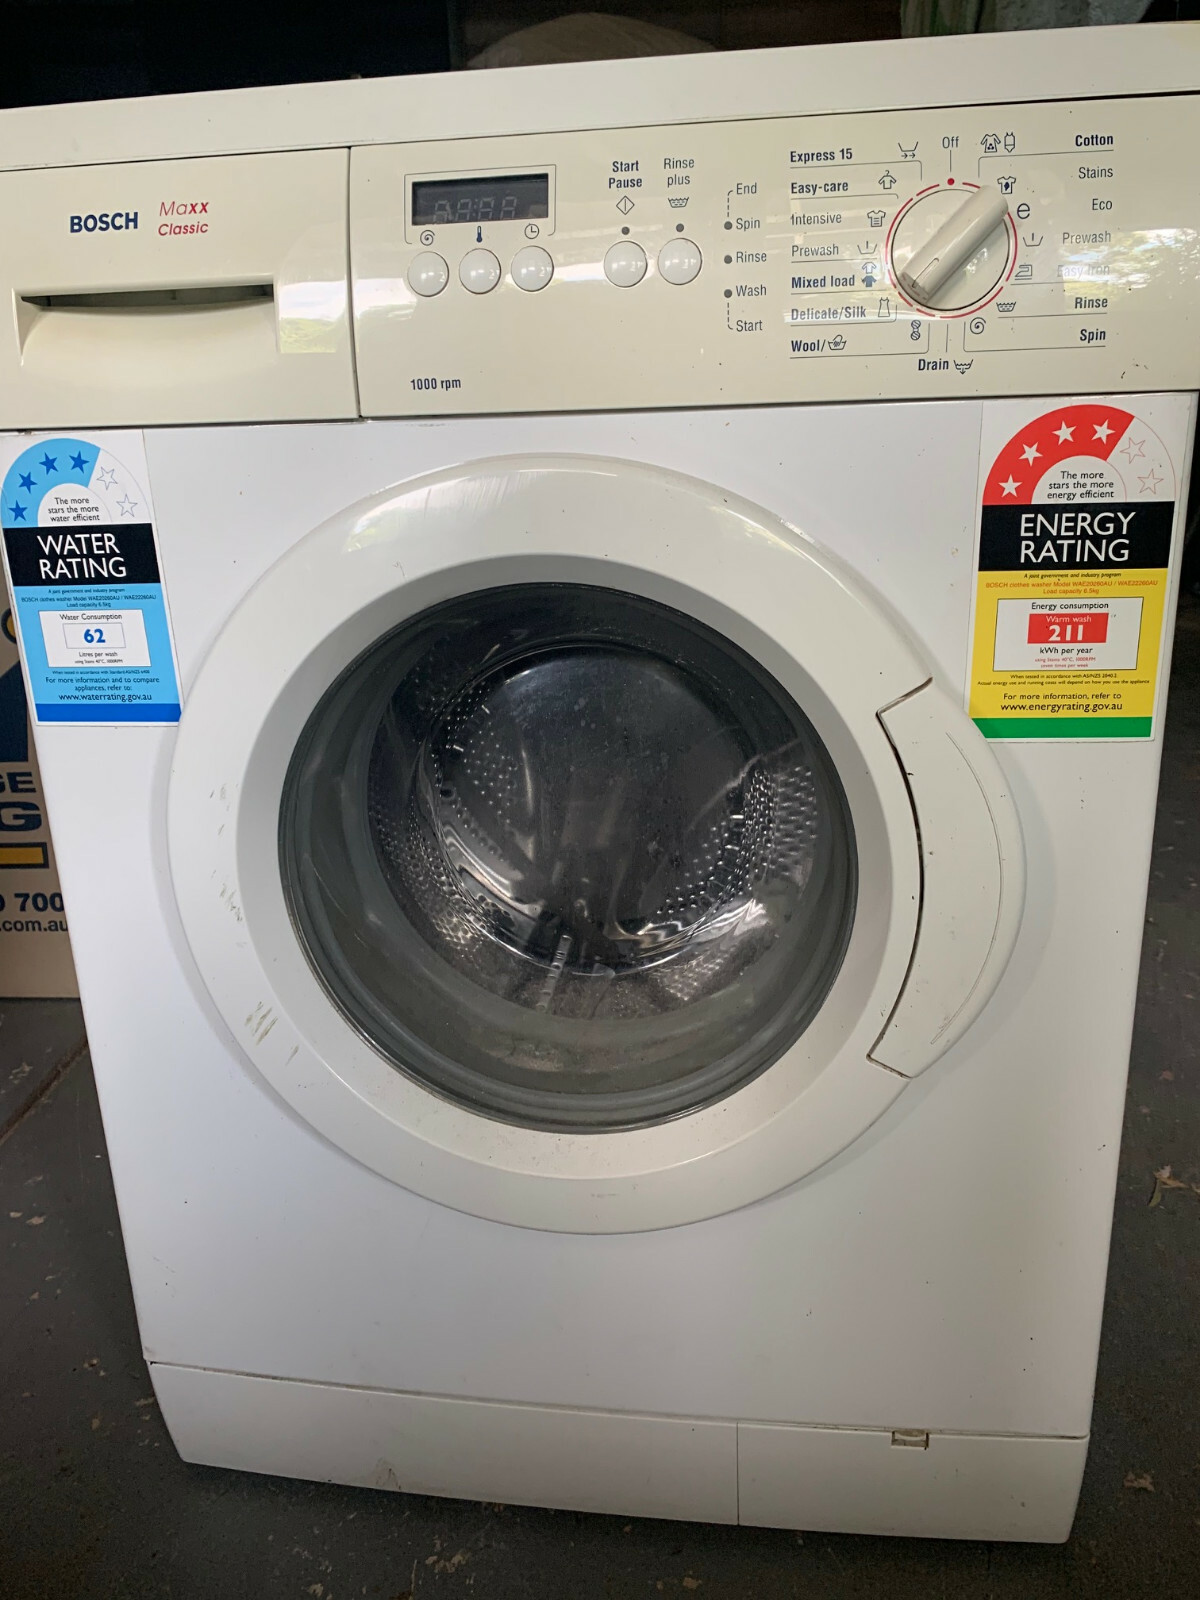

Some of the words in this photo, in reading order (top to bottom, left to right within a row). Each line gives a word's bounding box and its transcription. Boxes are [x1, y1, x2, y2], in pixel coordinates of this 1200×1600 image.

[942, 136, 960, 149] Off
[1074, 134, 1114, 147] Cotton
[790, 150, 836, 164] Express
[838, 148, 853, 160] 15
[612, 160, 640, 173] Start
[663, 158, 695, 170] Rinse
[1078, 166, 1114, 180] Stains
[608, 177, 643, 189] Pause
[667, 174, 690, 188] plus
[736, 182, 758, 195] End
[790, 182, 849, 196] Easy-care
[159, 200, 209, 216] Maxx
[1092, 198, 1112, 210] Eco
[70, 212, 138, 234] BOSCH
[736, 218, 760, 232] Spin
[790, 212, 842, 226] Intensive
[158, 221, 209, 236] Classic
[1062, 230, 1112, 244] Prewash
[791, 244, 839, 257] Prewash
[736, 251, 767, 264] Rinse
[791, 276, 826, 289] Mixed
[830, 275, 855, 288] load
[736, 284, 767, 297] Wash
[1074, 297, 1108, 309] Rinse
[790, 306, 867, 321] Delicate/Silk
[736, 320, 763, 332] Start
[1080, 328, 1106, 344] Spin
[790, 339, 826, 352] Wool/
[918, 358, 949, 371] Drain
[410, 378, 438, 390] 1000
[440, 378, 462, 392] rpm
[1060, 470, 1078, 480] The
[1048, 482, 1070, 490] stars
[1072, 480, 1087, 489] the
[54, 497, 68, 505] The
[1047, 491, 1077, 501] energy
[1080, 490, 1114, 498] efficient
[66, 505, 78, 514] the
[72, 513, 100, 522] efficient
[1020, 511, 1137, 537] ENERGY
[36, 532, 120, 556] WATER
[1020, 538, 1130, 564] RATING
[39, 556, 127, 580] RATING
[1031, 602, 1058, 611] Energy
[1059, 602, 1109, 610] consumption
[81, 613, 123, 621] Consumption
[1046, 615, 1070, 623] Warm
[1072, 615, 1092, 623] wash
[83, 628, 106, 644] 62
[1048, 624, 1084, 641] 211
[1076, 648, 1093, 656] year
[58, 693, 152, 702] www.waterrating.gov.au
[1003, 692, 1016, 700] For
[1042, 692, 1090, 700] information,
[1091, 692, 1110, 700] refer
[1000, 702, 1122, 713] www.energyrating.gov.au
